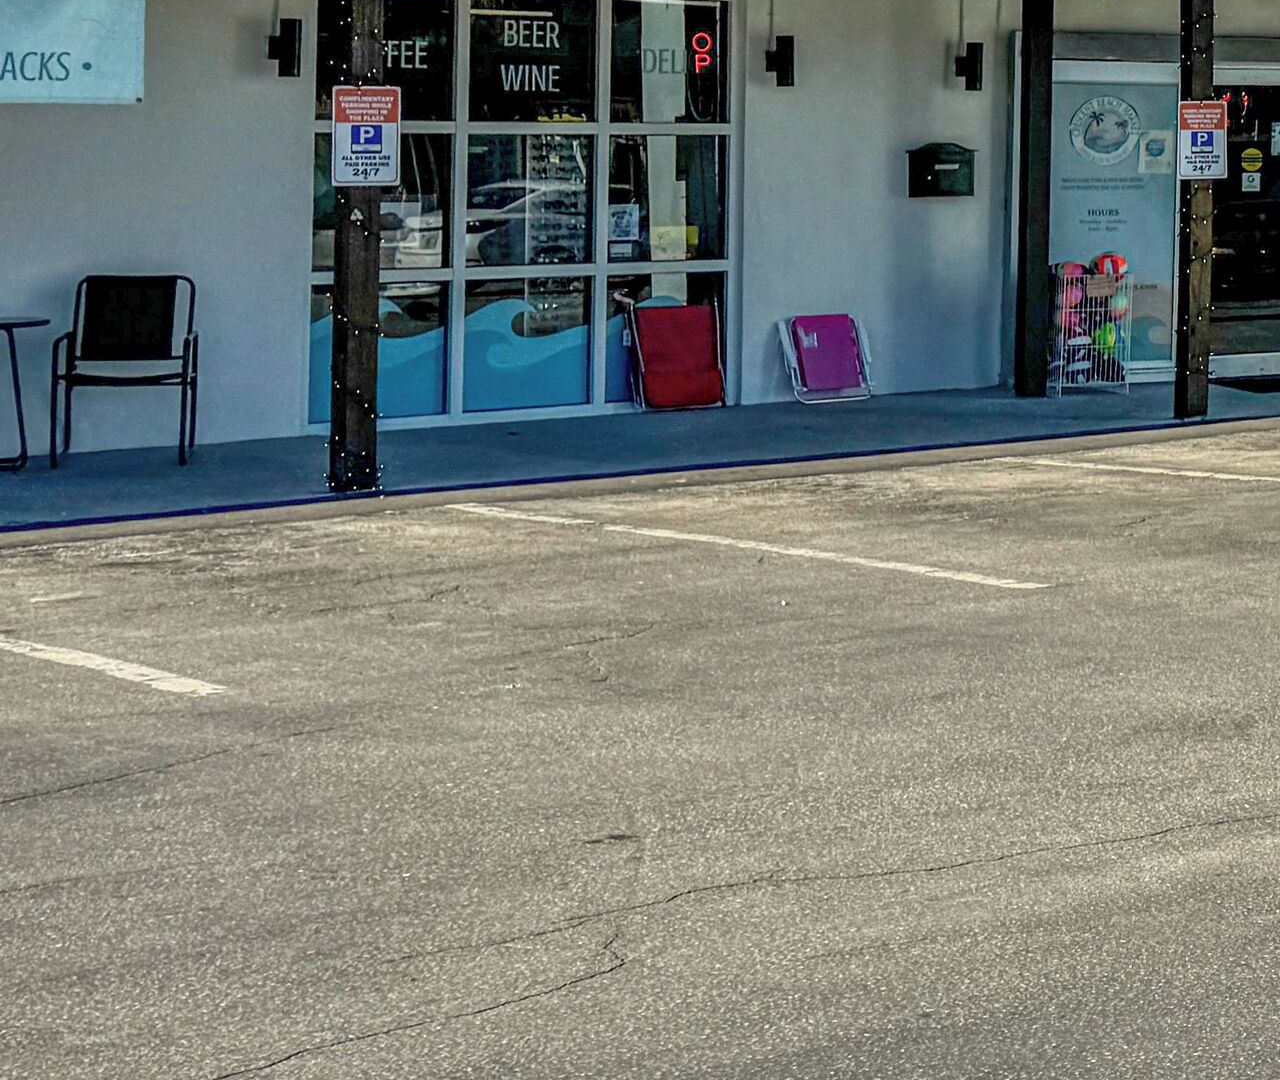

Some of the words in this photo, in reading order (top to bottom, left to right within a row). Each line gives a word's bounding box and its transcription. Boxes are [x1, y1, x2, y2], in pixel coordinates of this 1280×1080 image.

[503, 20, 560, 49] BEER
[500, 64, 561, 93] WINE
[360, 126, 375, 144] P
[1198, 133, 1208, 146] P
[352, 168, 380, 176] 24/7
[1087, 209, 1120, 217] HOURS
